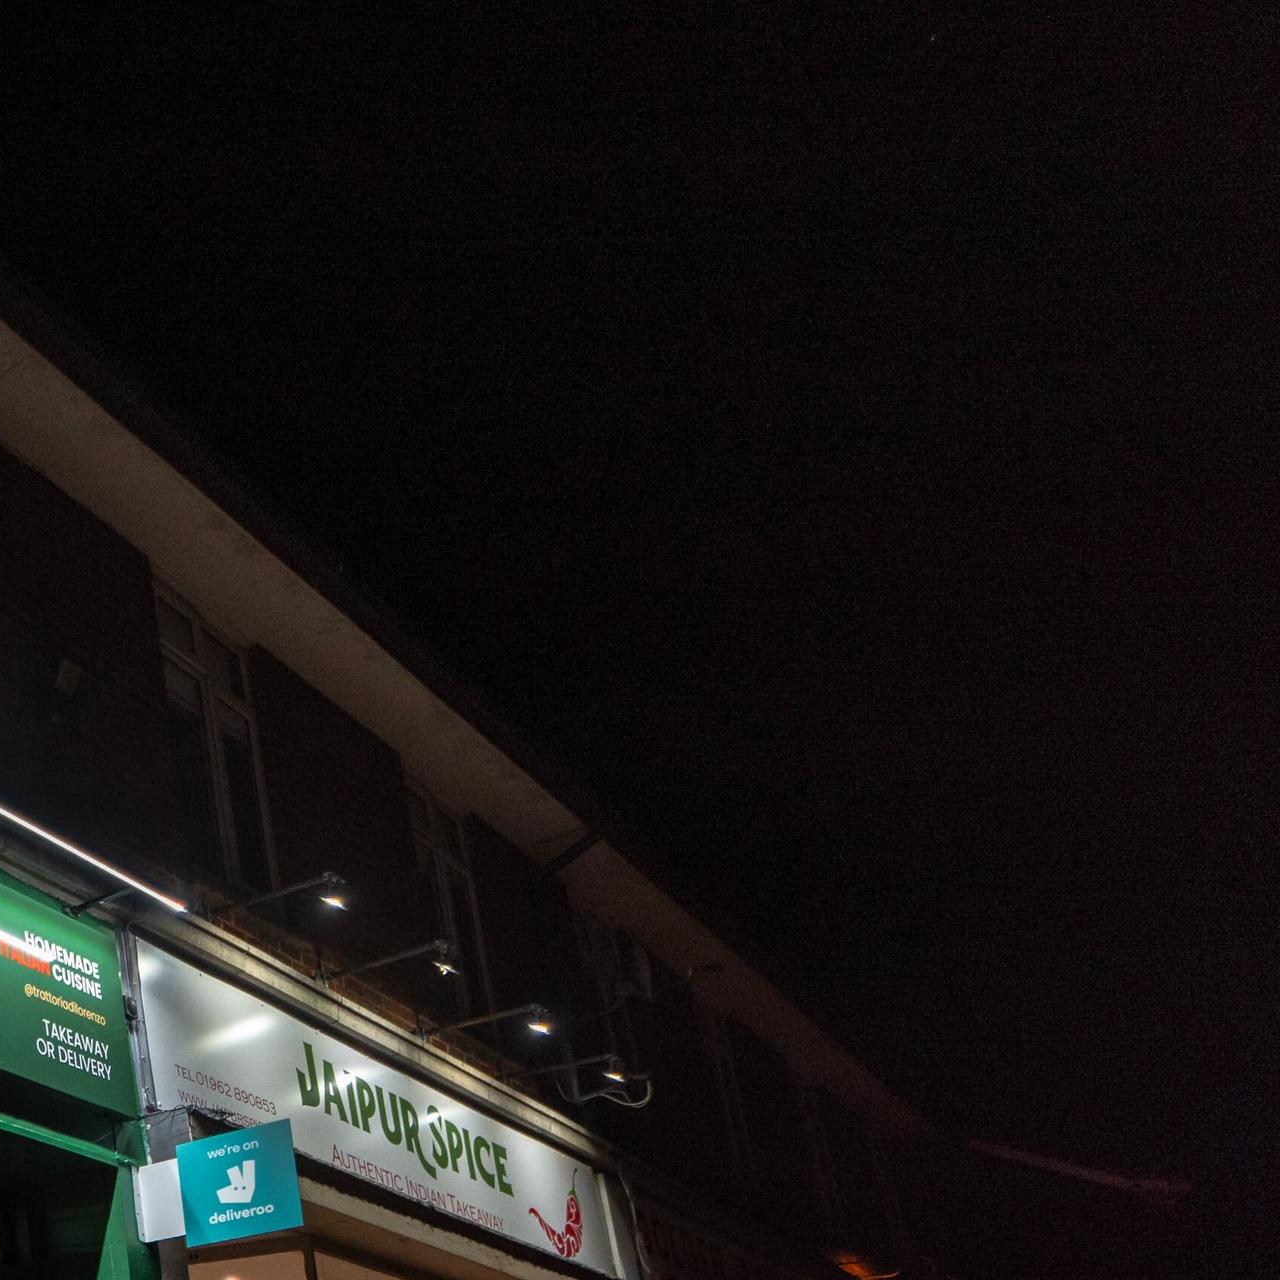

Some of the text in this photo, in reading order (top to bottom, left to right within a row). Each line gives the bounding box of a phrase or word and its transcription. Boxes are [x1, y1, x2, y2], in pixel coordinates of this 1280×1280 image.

[23, 930, 101, 980] HOMEMADE
[51, 963, 103, 1000] CUISINE
[23, 982, 107, 1027] @trattoriadilorenzo
[35, 1037, 113, 1082] OR DELIVERY
[41, 1018, 110, 1061] TAKEAWAY
[233, 1086, 278, 1116] 890853
[295, 1040, 516, 1198] JAIPUR SPICE
[206, 1139, 260, 1160] we're on
[331, 1143, 505, 1233] AUTHENTIC INDIAN TAKEAWAY
[208, 1203, 275, 1226] deliveroo
